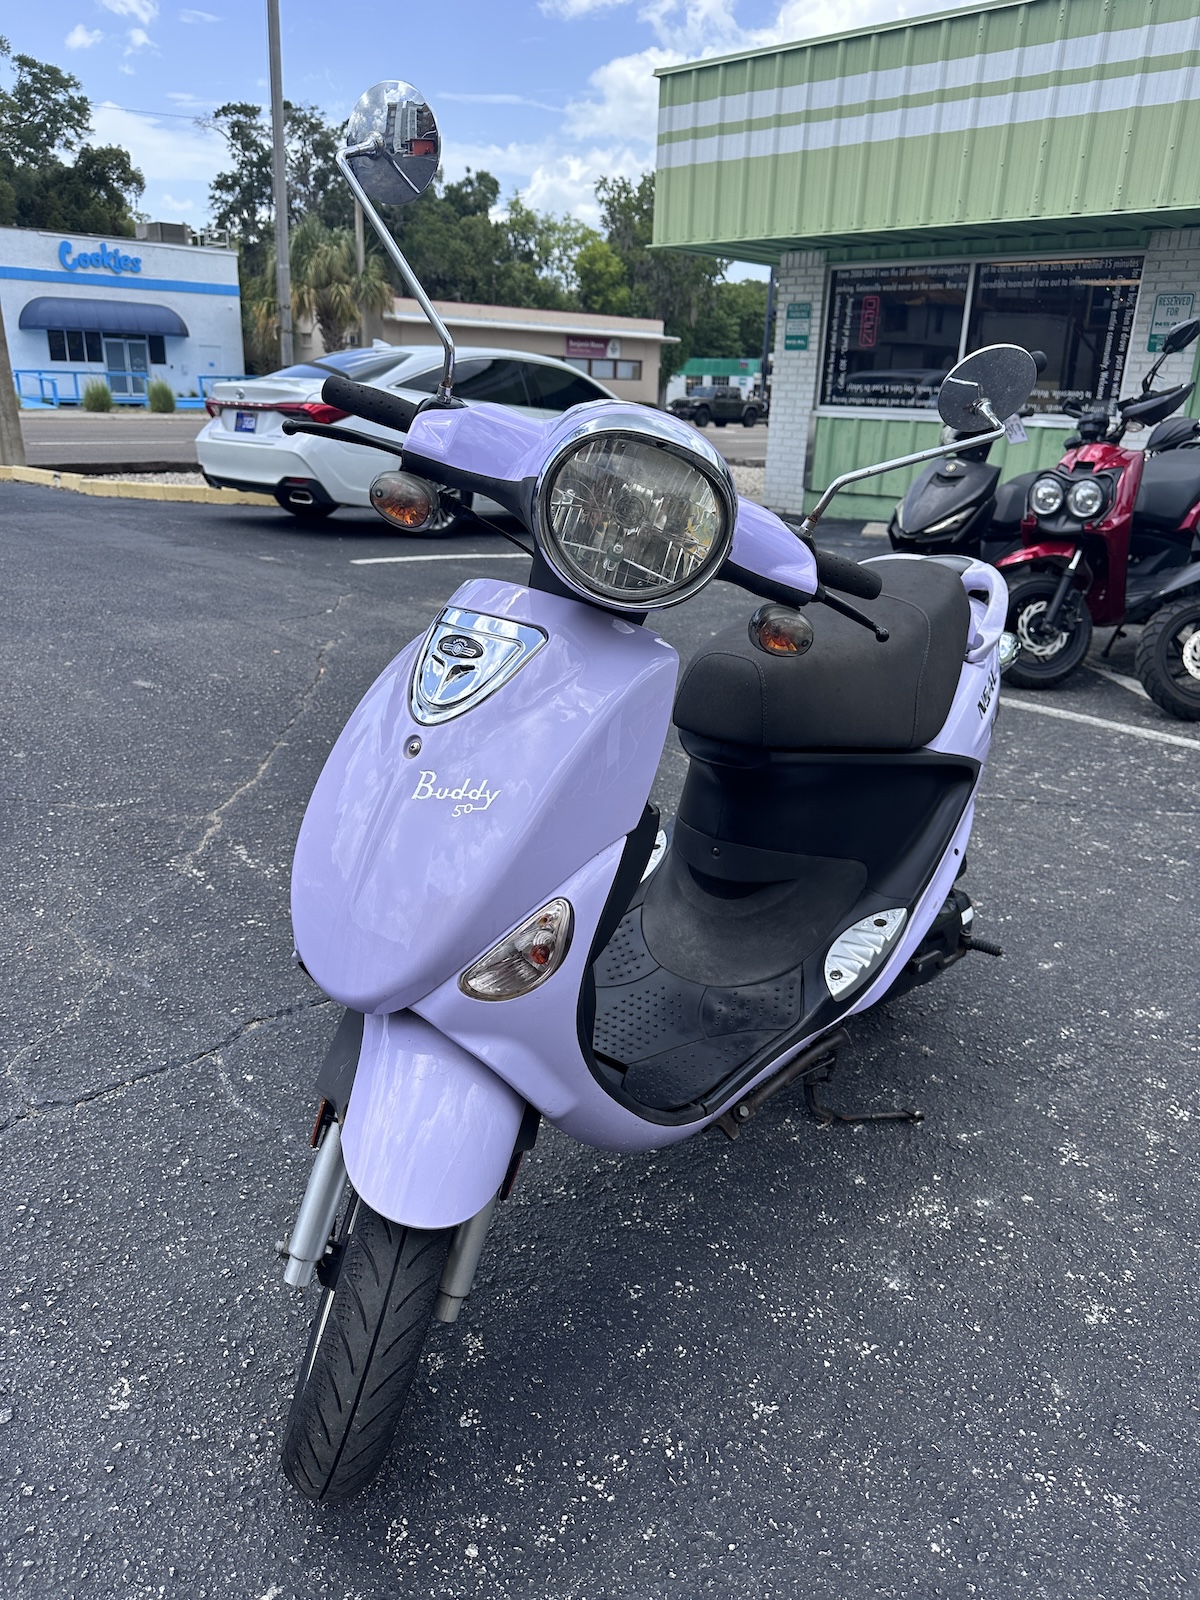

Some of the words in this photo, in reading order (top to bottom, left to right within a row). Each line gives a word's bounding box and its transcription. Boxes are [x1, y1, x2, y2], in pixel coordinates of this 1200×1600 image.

[58, 240, 142, 274] Cookies
[1113, 258, 1140, 270] minutes
[979, 278, 1007, 289] incredible
[1022, 278, 1035, 288] and
[1158, 296, 1191, 306] RESERVED
[1166, 307, 1180, 317] FOR
[862, 299, 876, 345] OPEN
[1107, 311, 1118, 331] entire
[1118, 332, 1130, 352] drove
[1030, 389, 1049, 399] Welco
[411, 770, 501, 811] Buddy
[451, 803, 474, 818] 50
